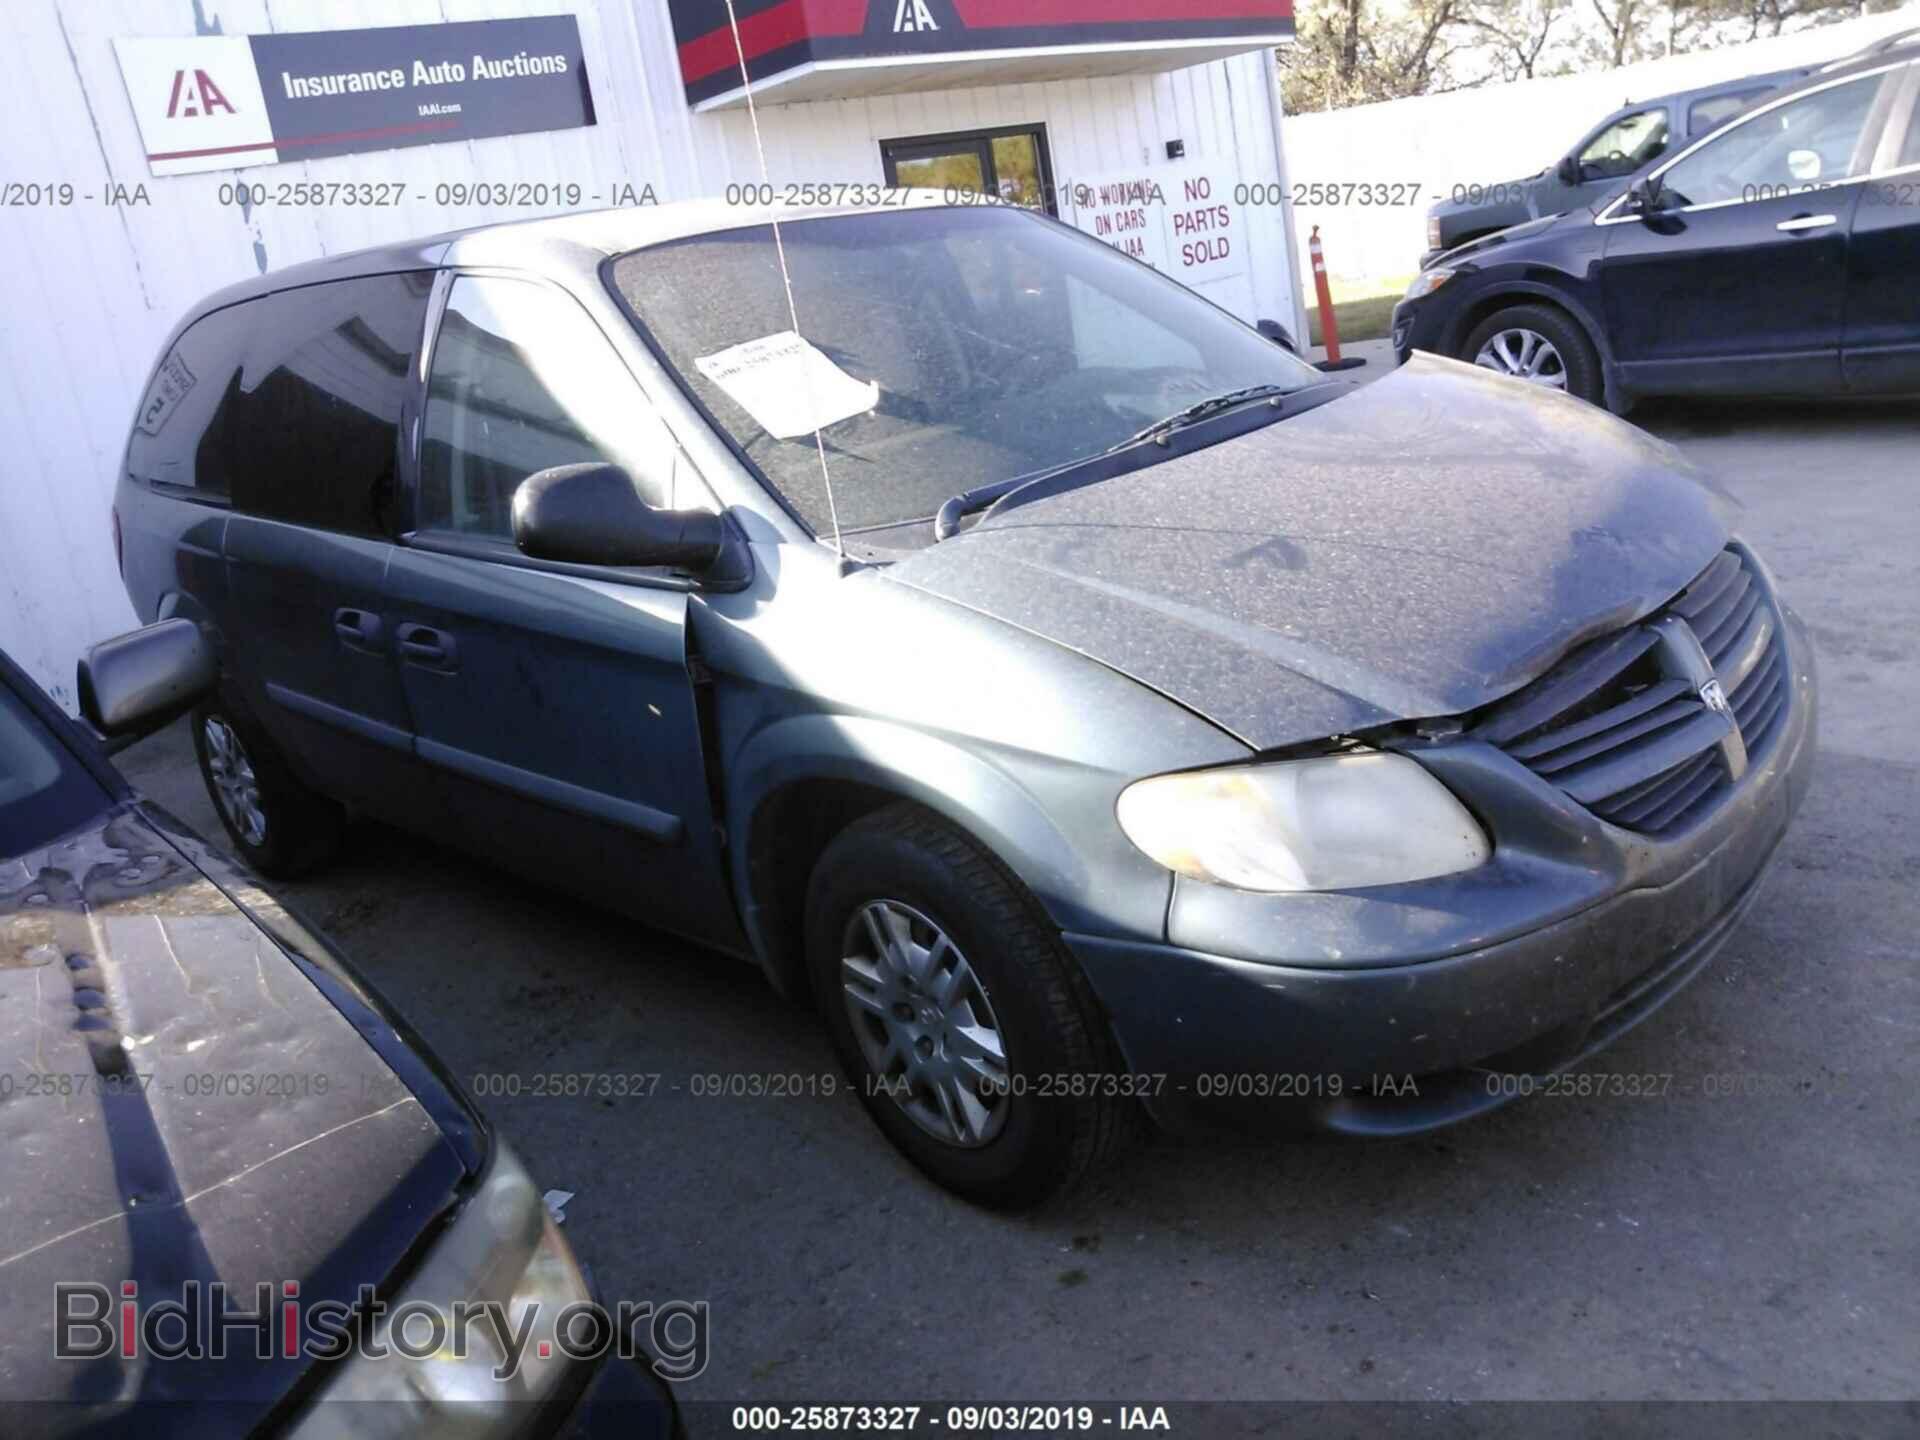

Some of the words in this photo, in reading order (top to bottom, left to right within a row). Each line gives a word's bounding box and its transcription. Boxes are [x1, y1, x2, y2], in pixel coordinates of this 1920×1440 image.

[893, 0, 937, 32] IAA
[282, 68, 405, 98] Insurance
[412, 60, 466, 86] Auto
[472, 51, 568, 80] Auctions
[166, 69, 237, 118] IAA
[418, 102, 462, 116] IAAI.com
[1184, 176, 1211, 202] NO
[1095, 214, 1112, 236] ON
[1115, 208, 1146, 232] CARS
[1173, 205, 1230, 236] PARTS
[1182, 237, 1230, 267] SOLD
